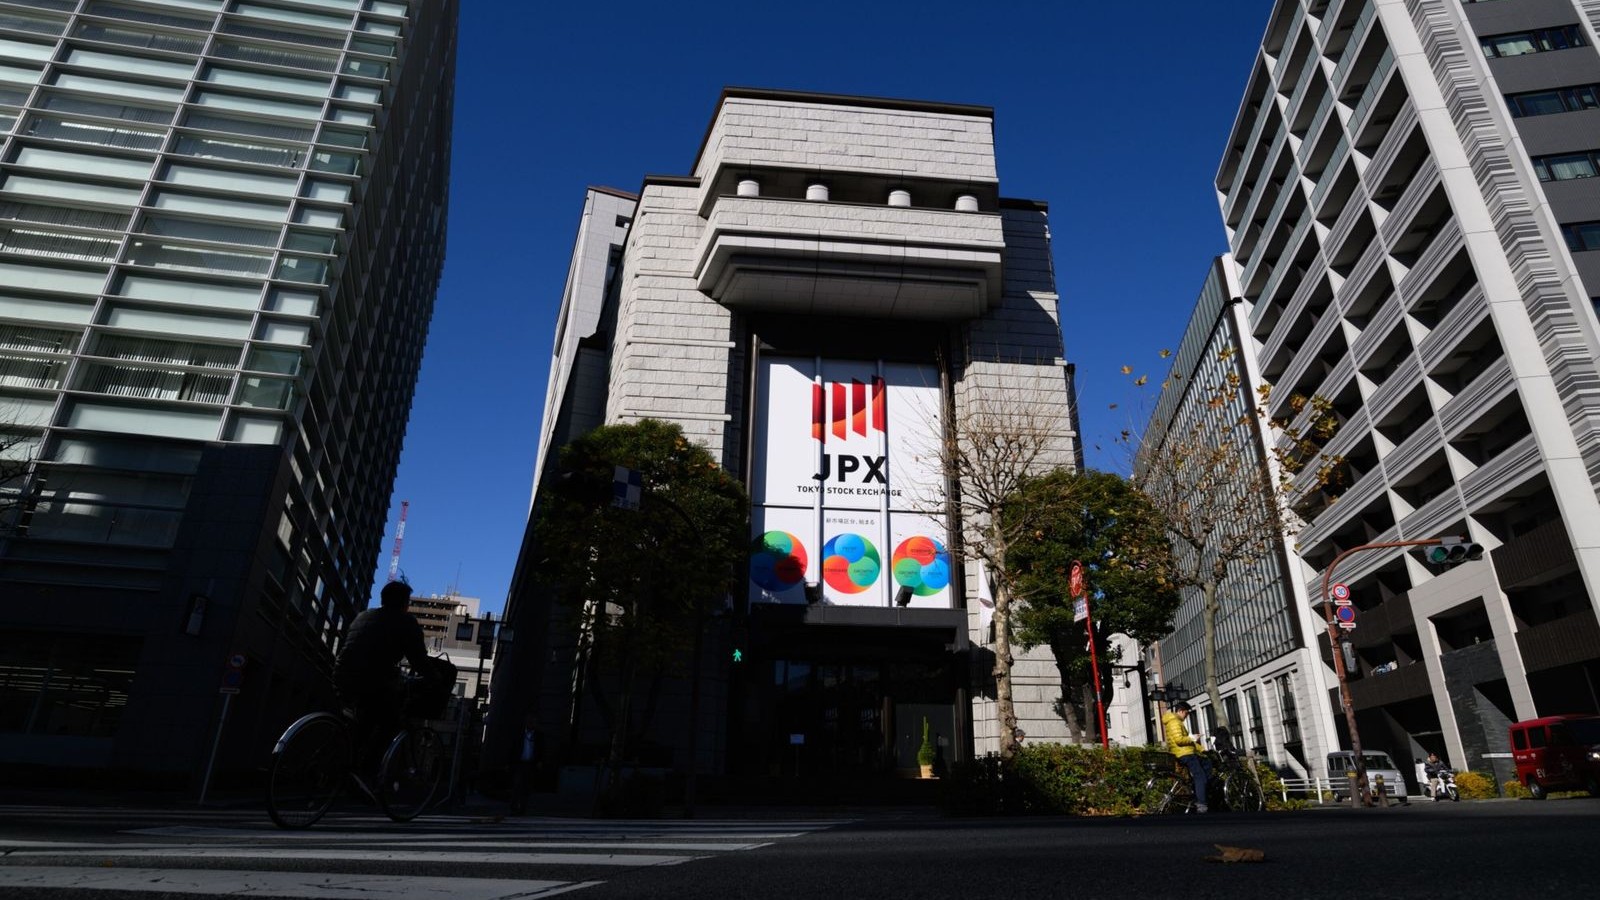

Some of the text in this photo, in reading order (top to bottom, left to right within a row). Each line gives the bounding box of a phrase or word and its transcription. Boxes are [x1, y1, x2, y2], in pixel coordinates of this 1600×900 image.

[812, 454, 886, 483] JPX
[797, 485, 903, 497] TOKYO STOCK EXCHANGE
[1536, 768, 1546, 778] EV
